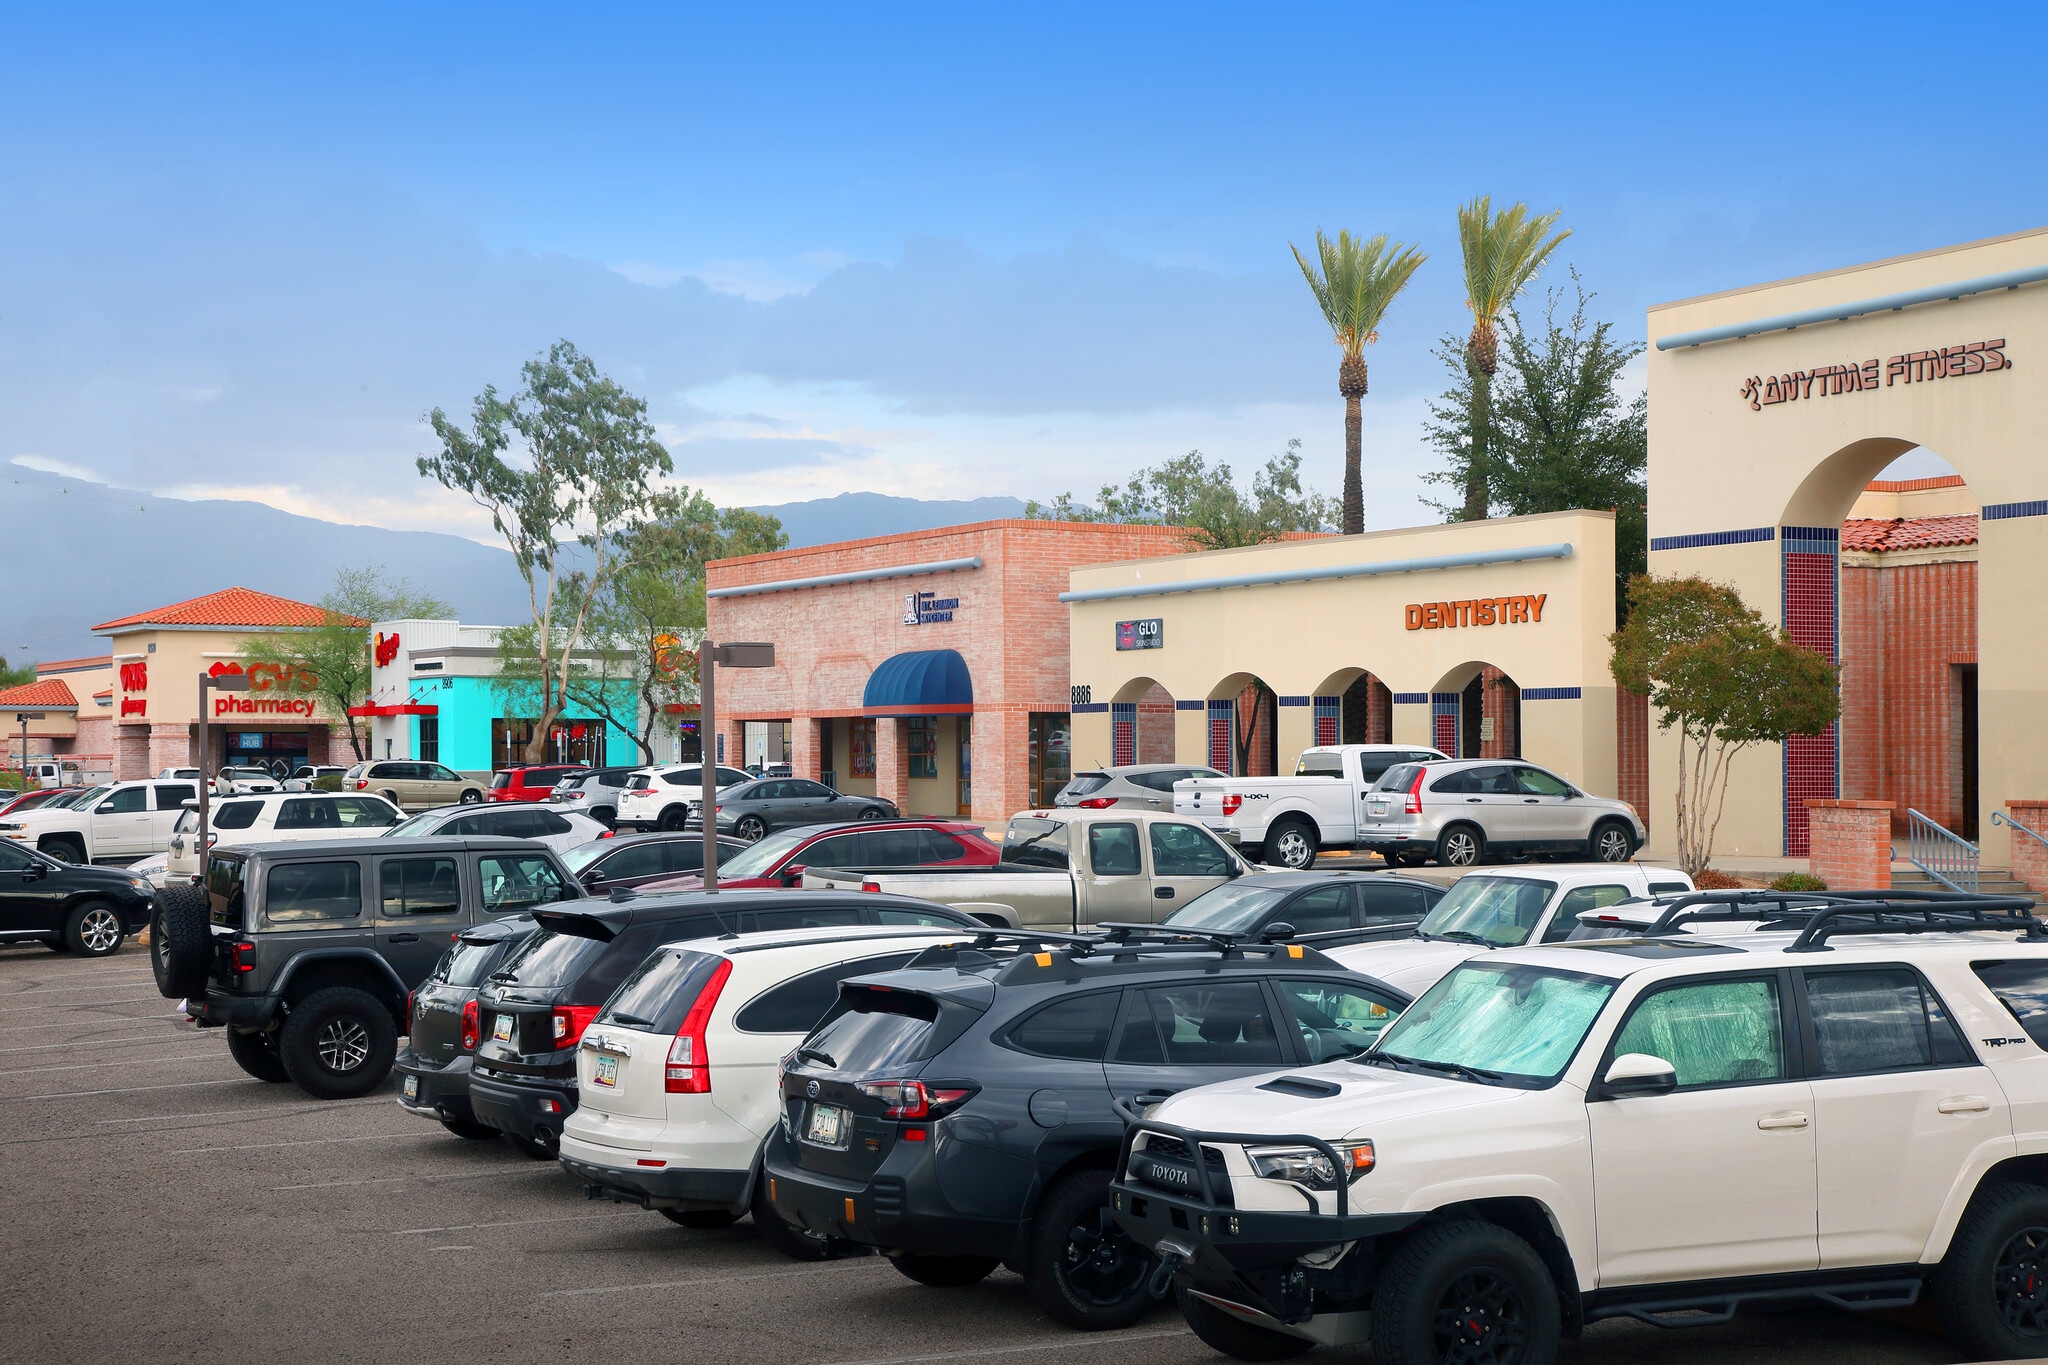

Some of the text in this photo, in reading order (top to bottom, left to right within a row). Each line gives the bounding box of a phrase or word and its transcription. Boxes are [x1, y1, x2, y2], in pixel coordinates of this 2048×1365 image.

[1763, 359, 1879, 405] ANYTIME
[1405, 594, 1547, 630] DENTISTRY
[1139, 621, 1157, 635] GLO
[246, 661, 319, 692] CVS
[1071, 685, 1091, 704] 8886
[215, 695, 317, 718] pharmacy
[1152, 1164, 1188, 1185] TOYOTA
